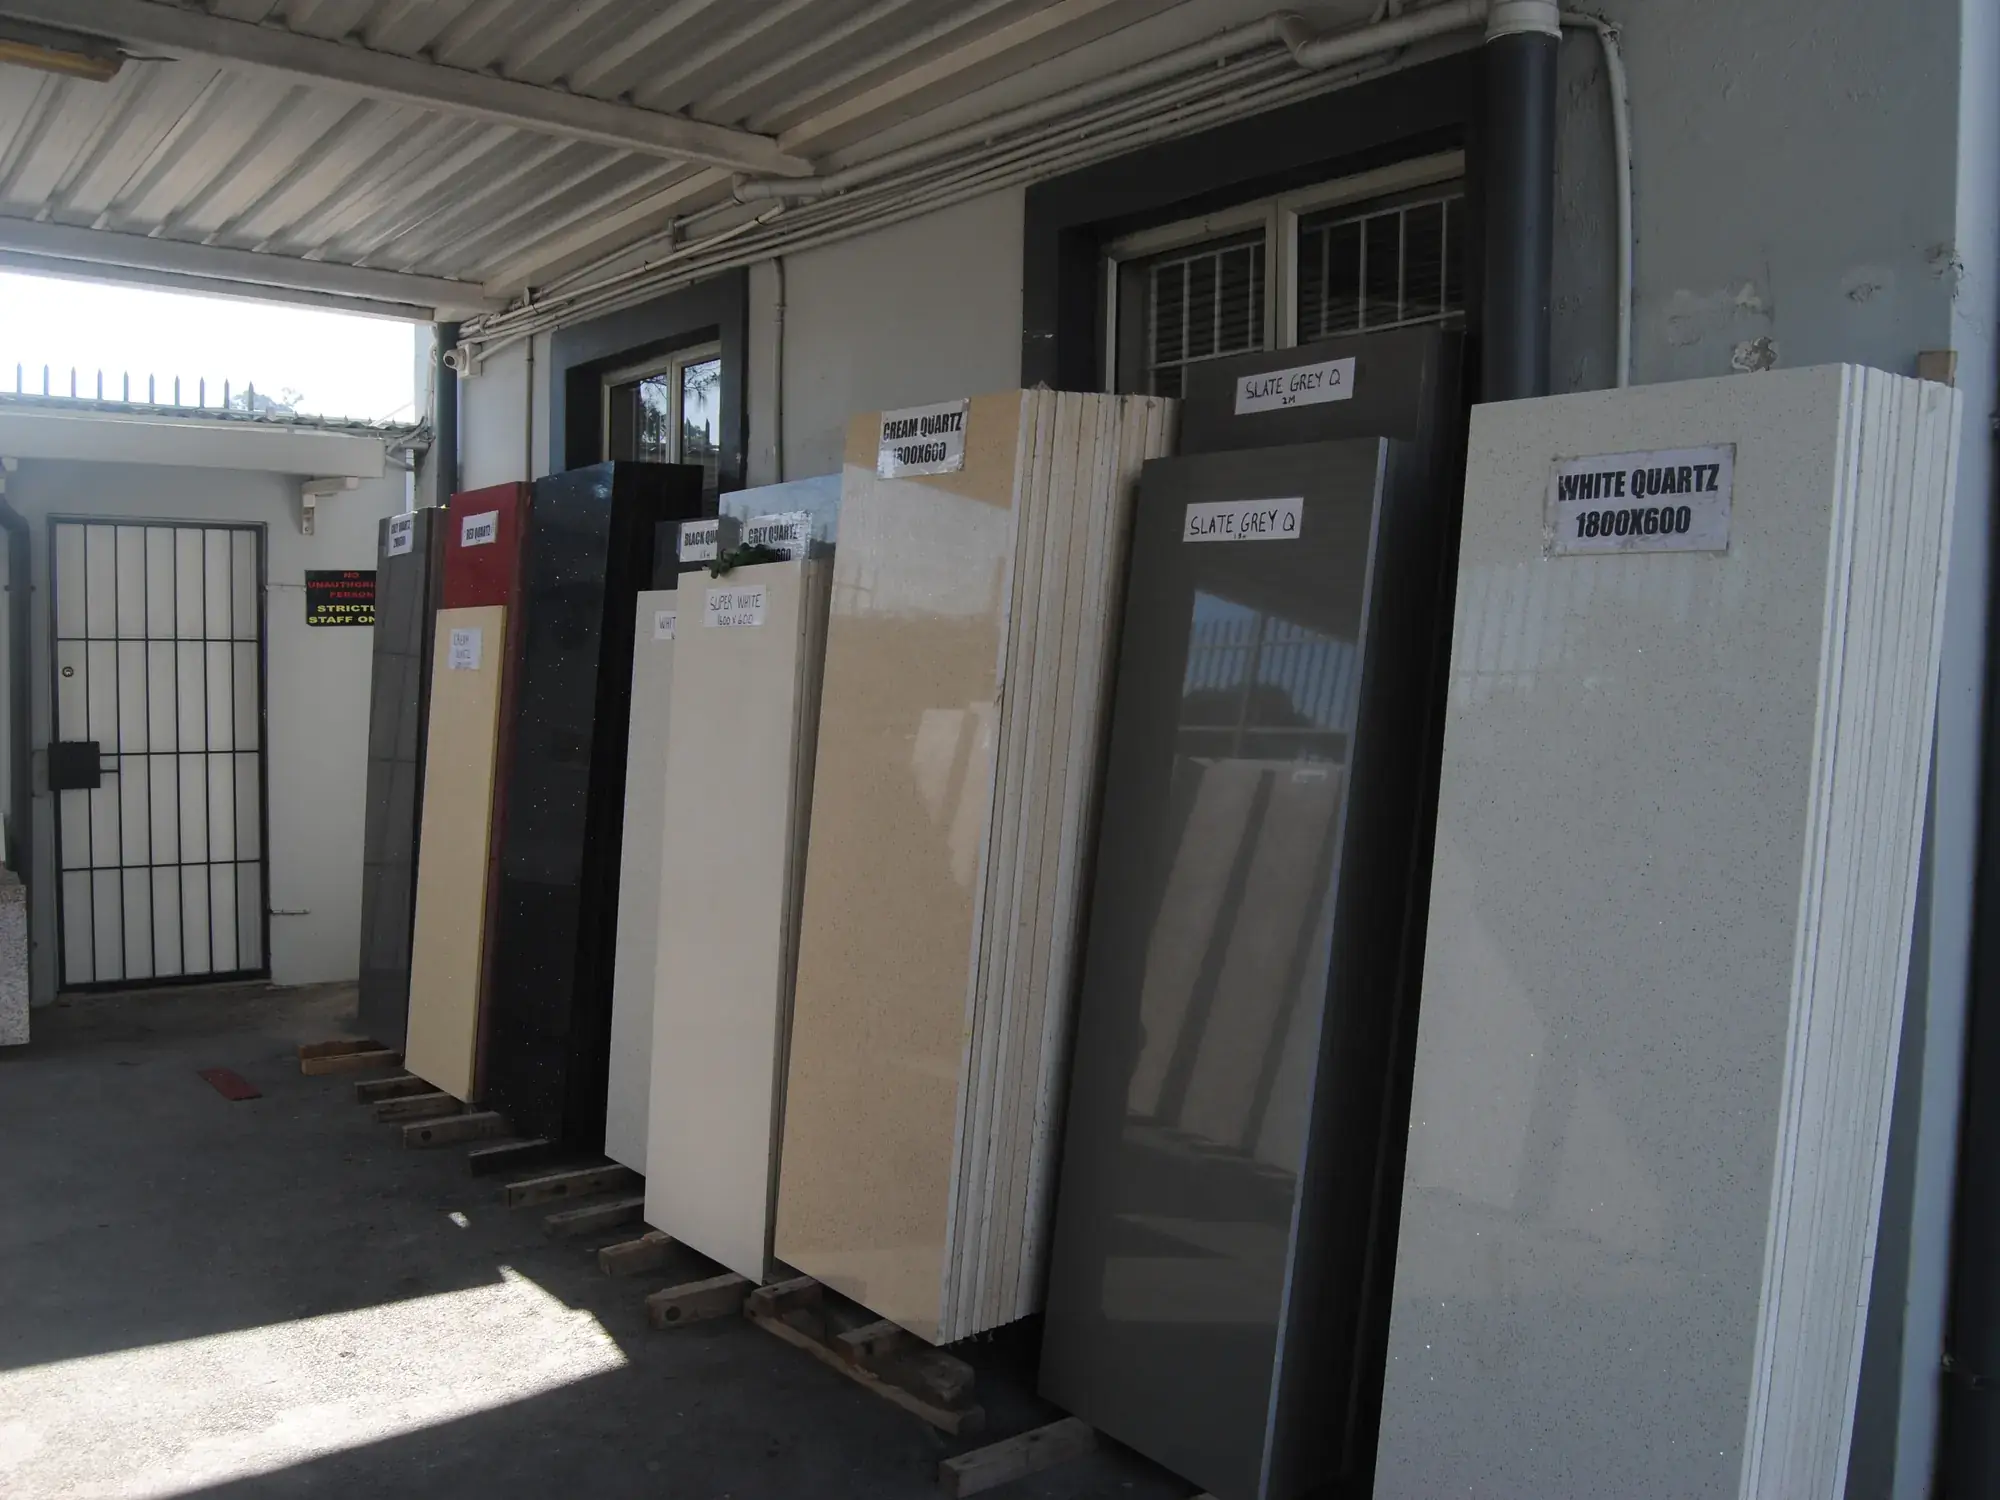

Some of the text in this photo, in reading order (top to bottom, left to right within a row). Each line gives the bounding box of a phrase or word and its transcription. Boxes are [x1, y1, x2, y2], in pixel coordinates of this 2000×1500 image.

[1246, 369, 1342, 399] SLATE GREY Q
[883, 412, 963, 441] CREAM QUARTZ
[1558, 464, 1720, 502] WHITE QUARTZ
[1189, 508, 1296, 535] SLATE GREY Q
[1576, 506, 1691, 538] 1800X600
[466, 525, 491, 541] RED QUARTZ
[684, 530, 705, 546] BLACK
[748, 524, 798, 545] GREY QUARTZ
[710, 592, 762, 610] SUPER WHITE
[308, 616, 353, 624] STAFF
[738, 614, 754, 624] 600
